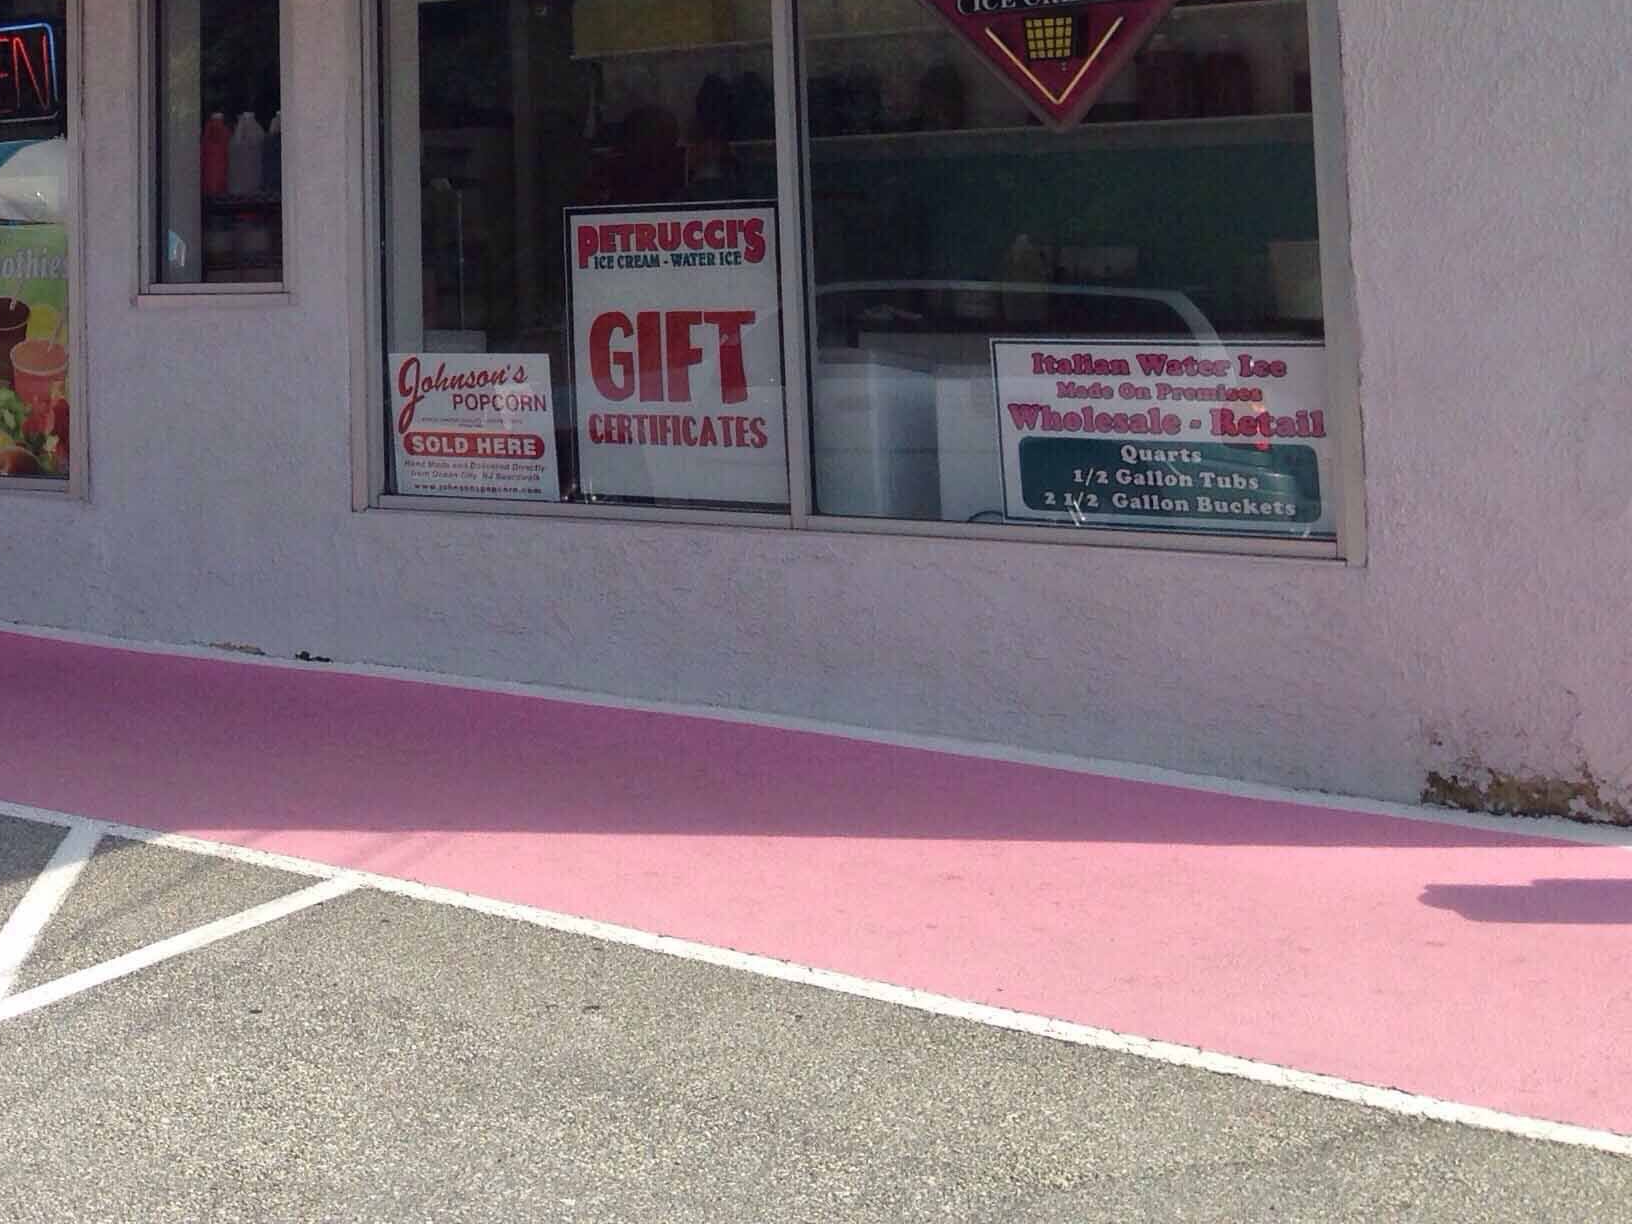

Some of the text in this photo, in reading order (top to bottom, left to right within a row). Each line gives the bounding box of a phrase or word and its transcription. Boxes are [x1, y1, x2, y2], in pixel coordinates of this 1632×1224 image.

[577, 217, 766, 269] PETRUCCI'S
[594, 255, 614, 270] ICE
[618, 253, 660, 268] CREAM
[671, 252, 716, 267] WATER
[719, 251, 742, 265] ICE
[589, 310, 756, 404] GIFT
[1031, 352, 1287, 377] Italian Water Ice
[398, 357, 528, 434] Johnson's
[453, 394, 547, 412] POPCORN
[1056, 381, 1263, 401] Made On Premises
[588, 413, 768, 449] CERTIFICATES
[1008, 403, 1182, 434] Wholesale
[1210, 408, 1327, 438] Retail
[411, 436, 537, 456] SOLD HERE
[1121, 444, 1202, 464] Quarts
[1073, 468, 1259, 490] 1/2 Gallon Tubs
[1044, 491, 1296, 516] 2 1/2 Gallon Buckets
